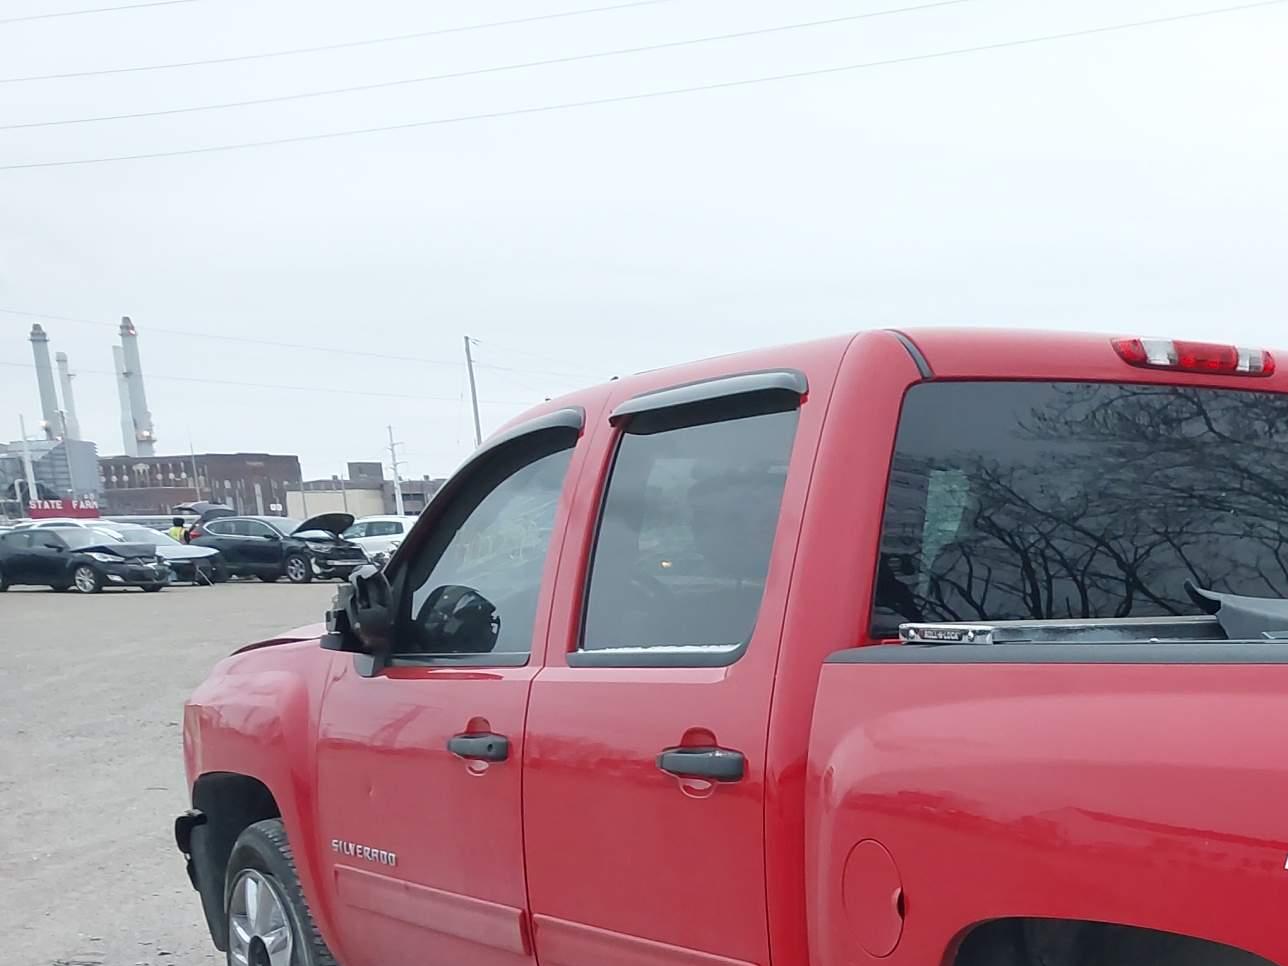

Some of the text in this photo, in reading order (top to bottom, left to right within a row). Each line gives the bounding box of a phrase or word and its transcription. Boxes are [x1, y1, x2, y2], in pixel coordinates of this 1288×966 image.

[29, 500, 98, 509] STATE FARM
[331, 839, 396, 866] SILVERADO
